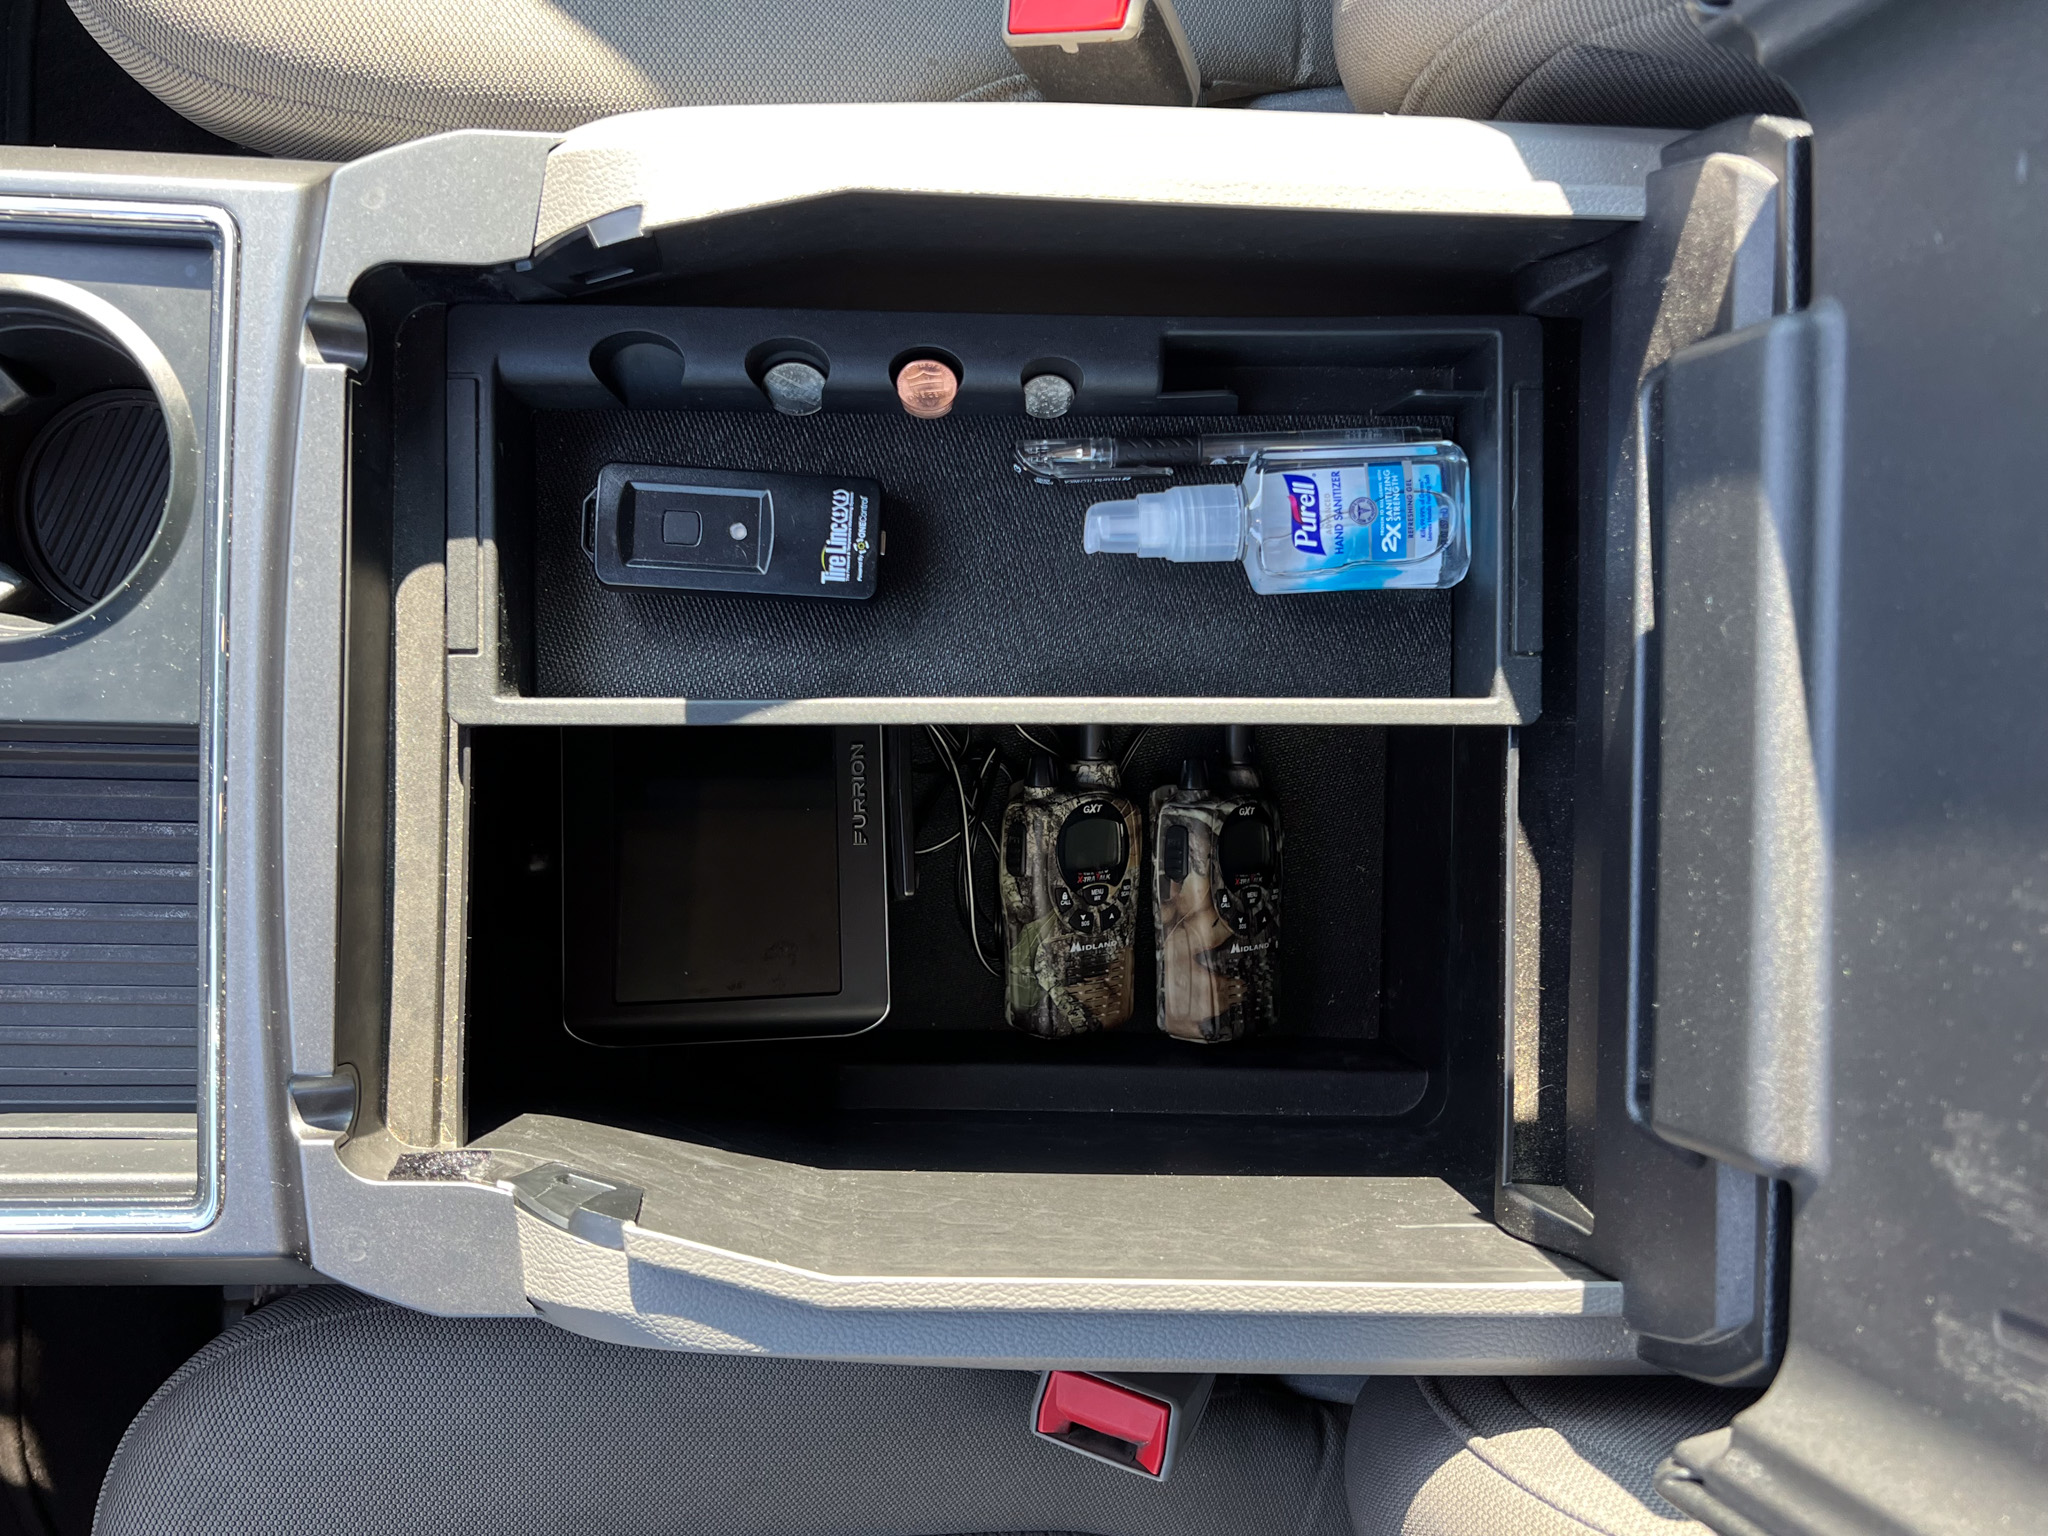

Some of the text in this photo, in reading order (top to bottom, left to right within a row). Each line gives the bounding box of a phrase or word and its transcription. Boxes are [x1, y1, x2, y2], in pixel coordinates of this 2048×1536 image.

[1292, 482, 1317, 547] Purell
[1324, 493, 1332, 535] ADVANCED
[1331, 471, 1344, 555] HAND SANITIZER
[1383, 469, 1394, 522] SANITIZING
[1391, 475, 1401, 522] STRENGTH
[1406, 494, 1414, 538] REFRESHING
[1381, 523, 1401, 553] 2X
[851, 744, 868, 845] FURRION
[1083, 804, 1103, 814] GXT
[1239, 807, 1255, 816] GXT
[1091, 888, 1104, 896] MENU
[1070, 940, 1118, 953] MIDLAND
[1230, 942, 1269, 954] MIDLAND
